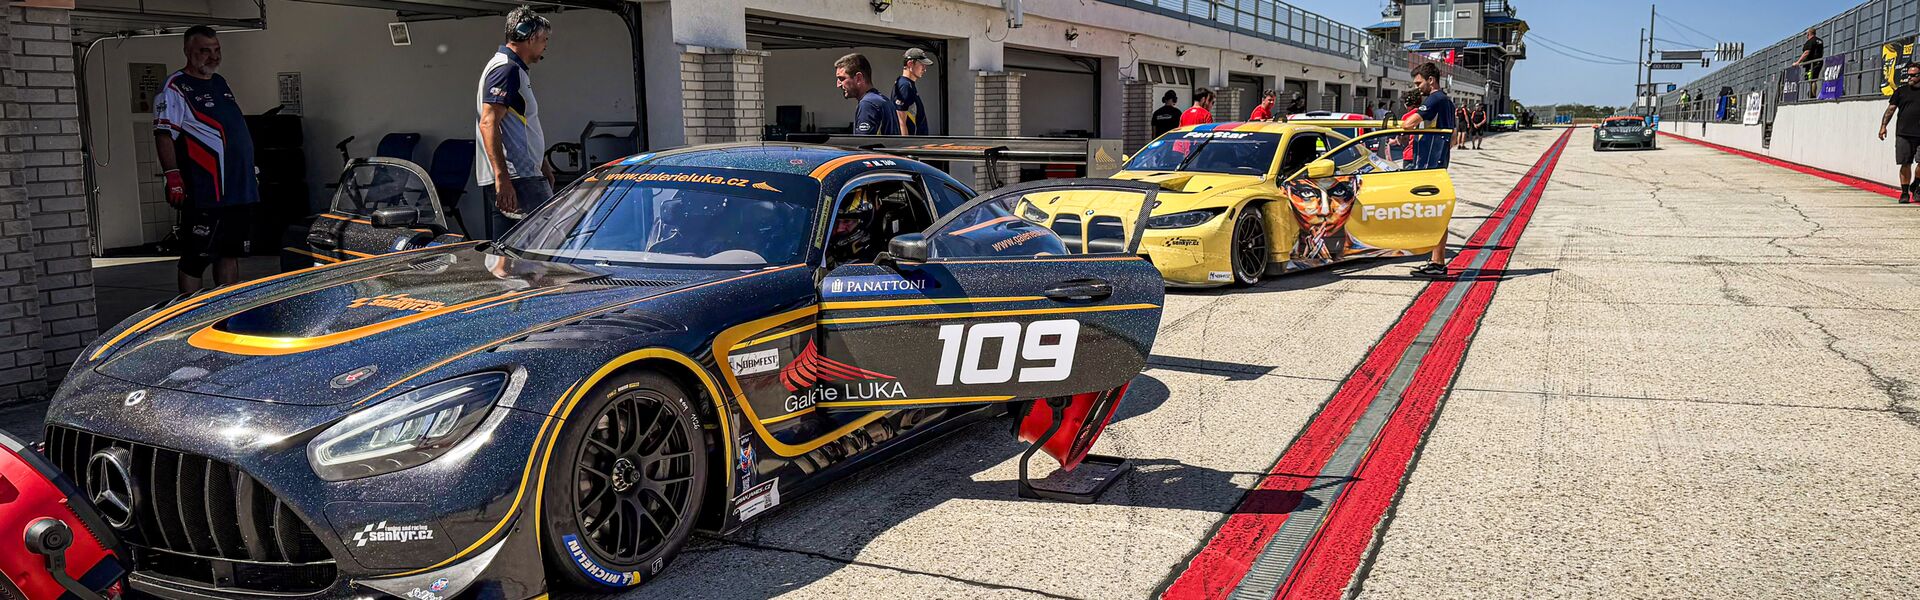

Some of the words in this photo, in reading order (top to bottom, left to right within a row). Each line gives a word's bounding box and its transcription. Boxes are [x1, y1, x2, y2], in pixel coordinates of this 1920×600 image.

[1183, 131, 1249, 139] FenStar
[604, 171, 750, 187] www.galerieluka.cz
[1361, 202, 1446, 221] FenStar
[846, 279, 925, 293] PANATTONI
[936, 319, 1080, 386] 109
[735, 354, 778, 375] NORMFEST
[845, 381, 907, 400] LUKA
[369, 529, 434, 543] senkyr.cz
[567, 539, 621, 584] MICHELIN
